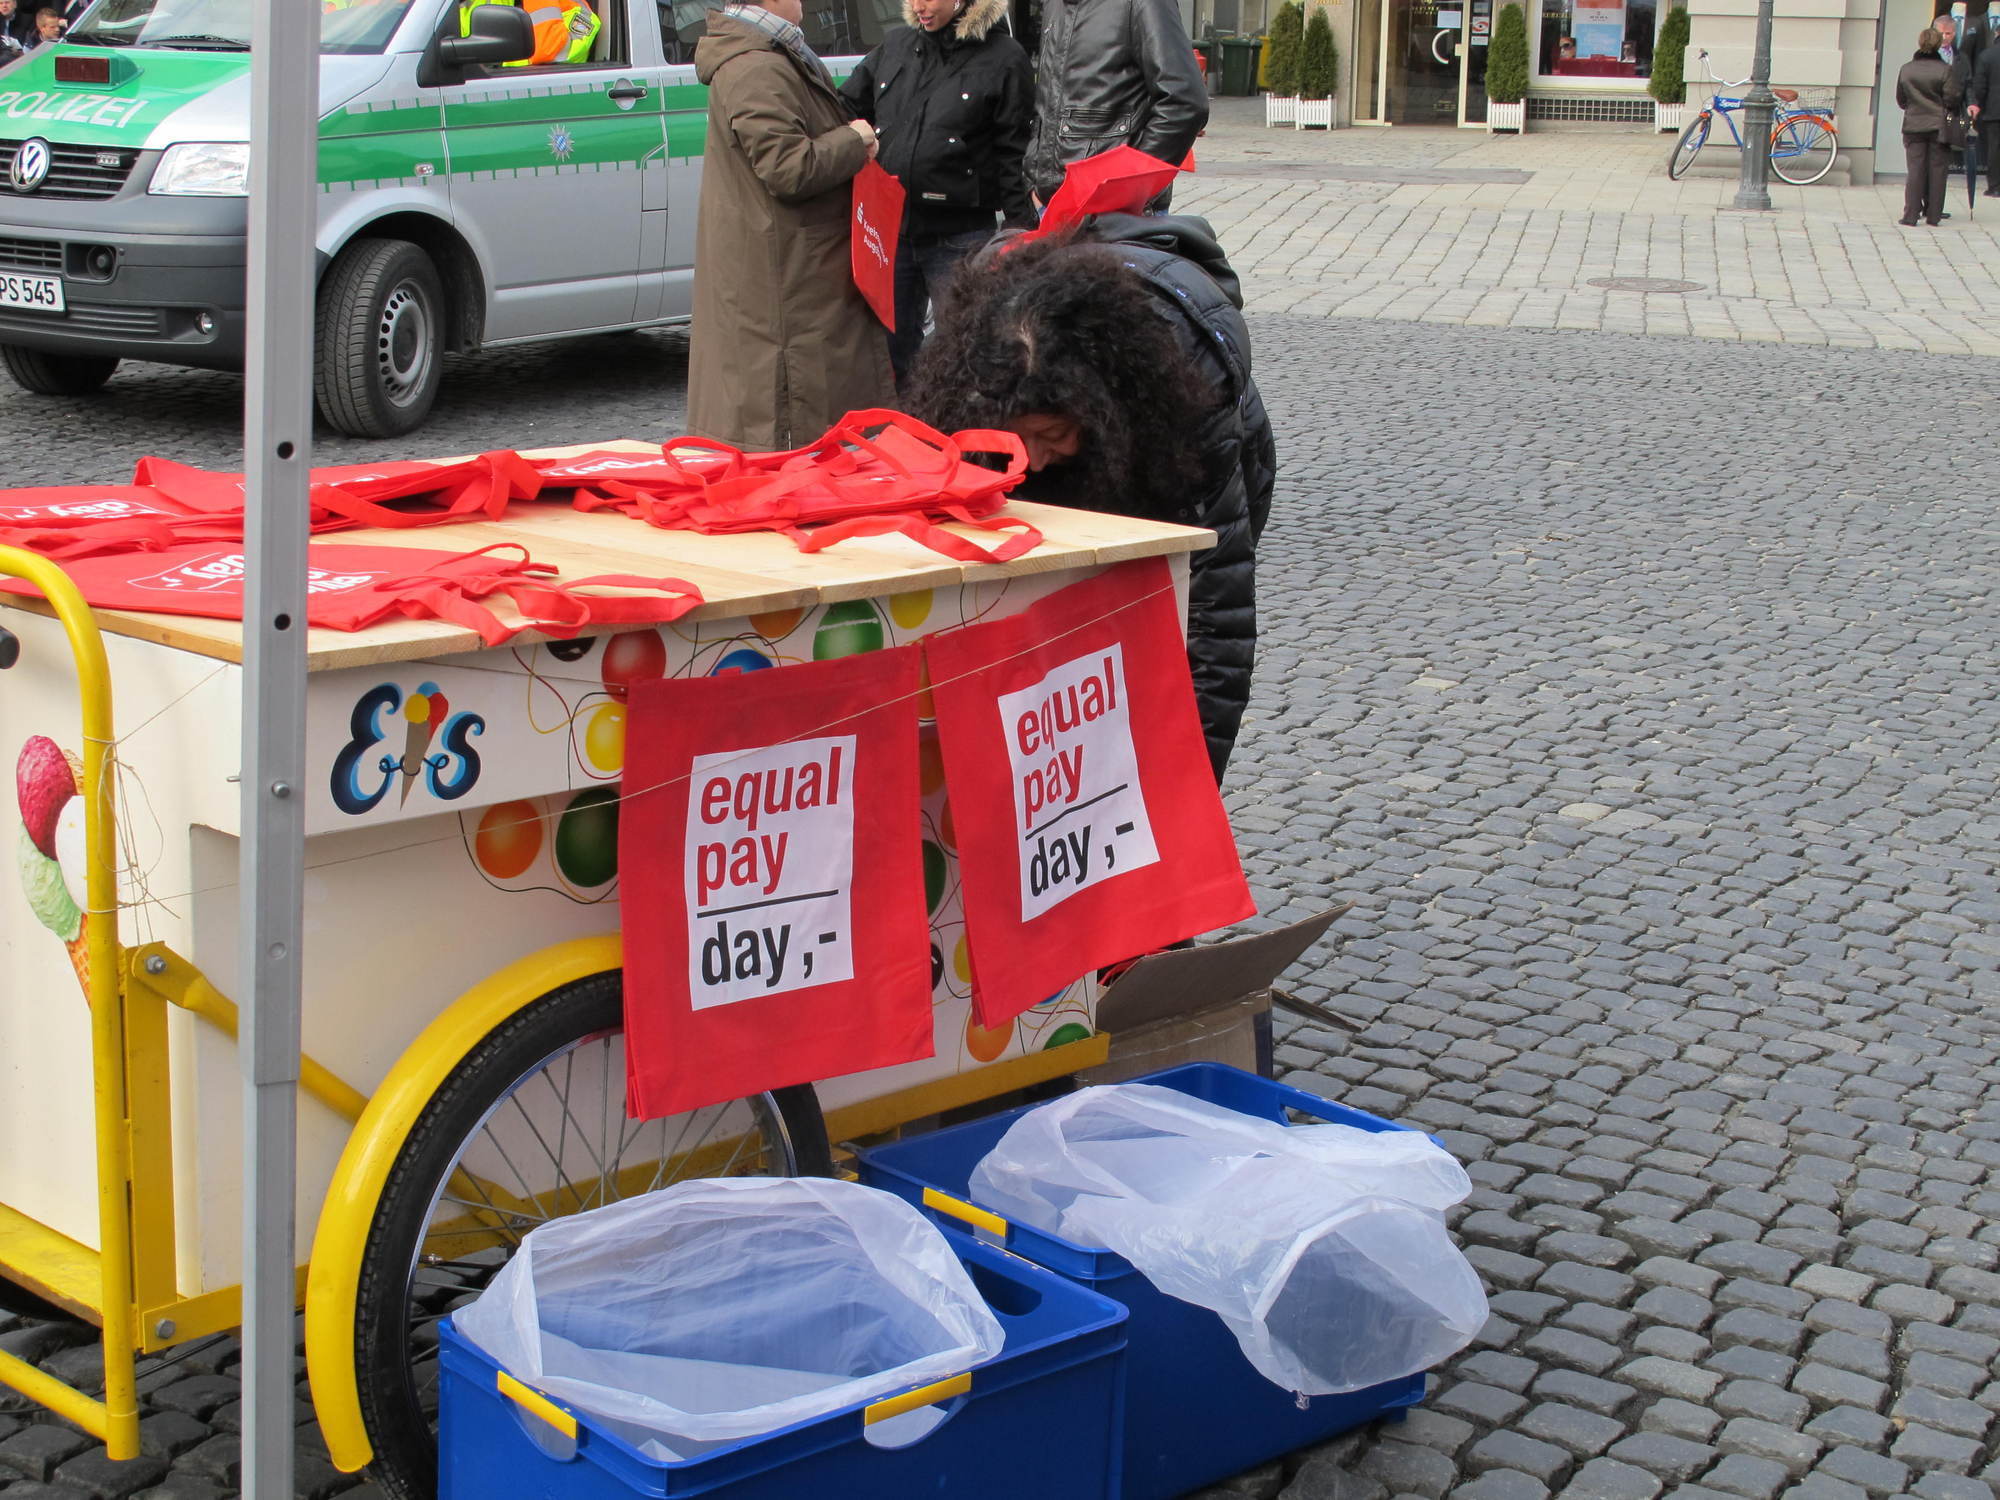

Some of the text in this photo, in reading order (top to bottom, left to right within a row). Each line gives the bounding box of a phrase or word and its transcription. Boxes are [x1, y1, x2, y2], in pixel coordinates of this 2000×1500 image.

[0, 91, 149, 128] POLIZEI
[22, 279, 56, 305] 545
[1016, 656, 1117, 756] equal
[700, 746, 842, 832] equal
[1023, 744, 1084, 830] pay
[697, 831, 789, 907] pay
